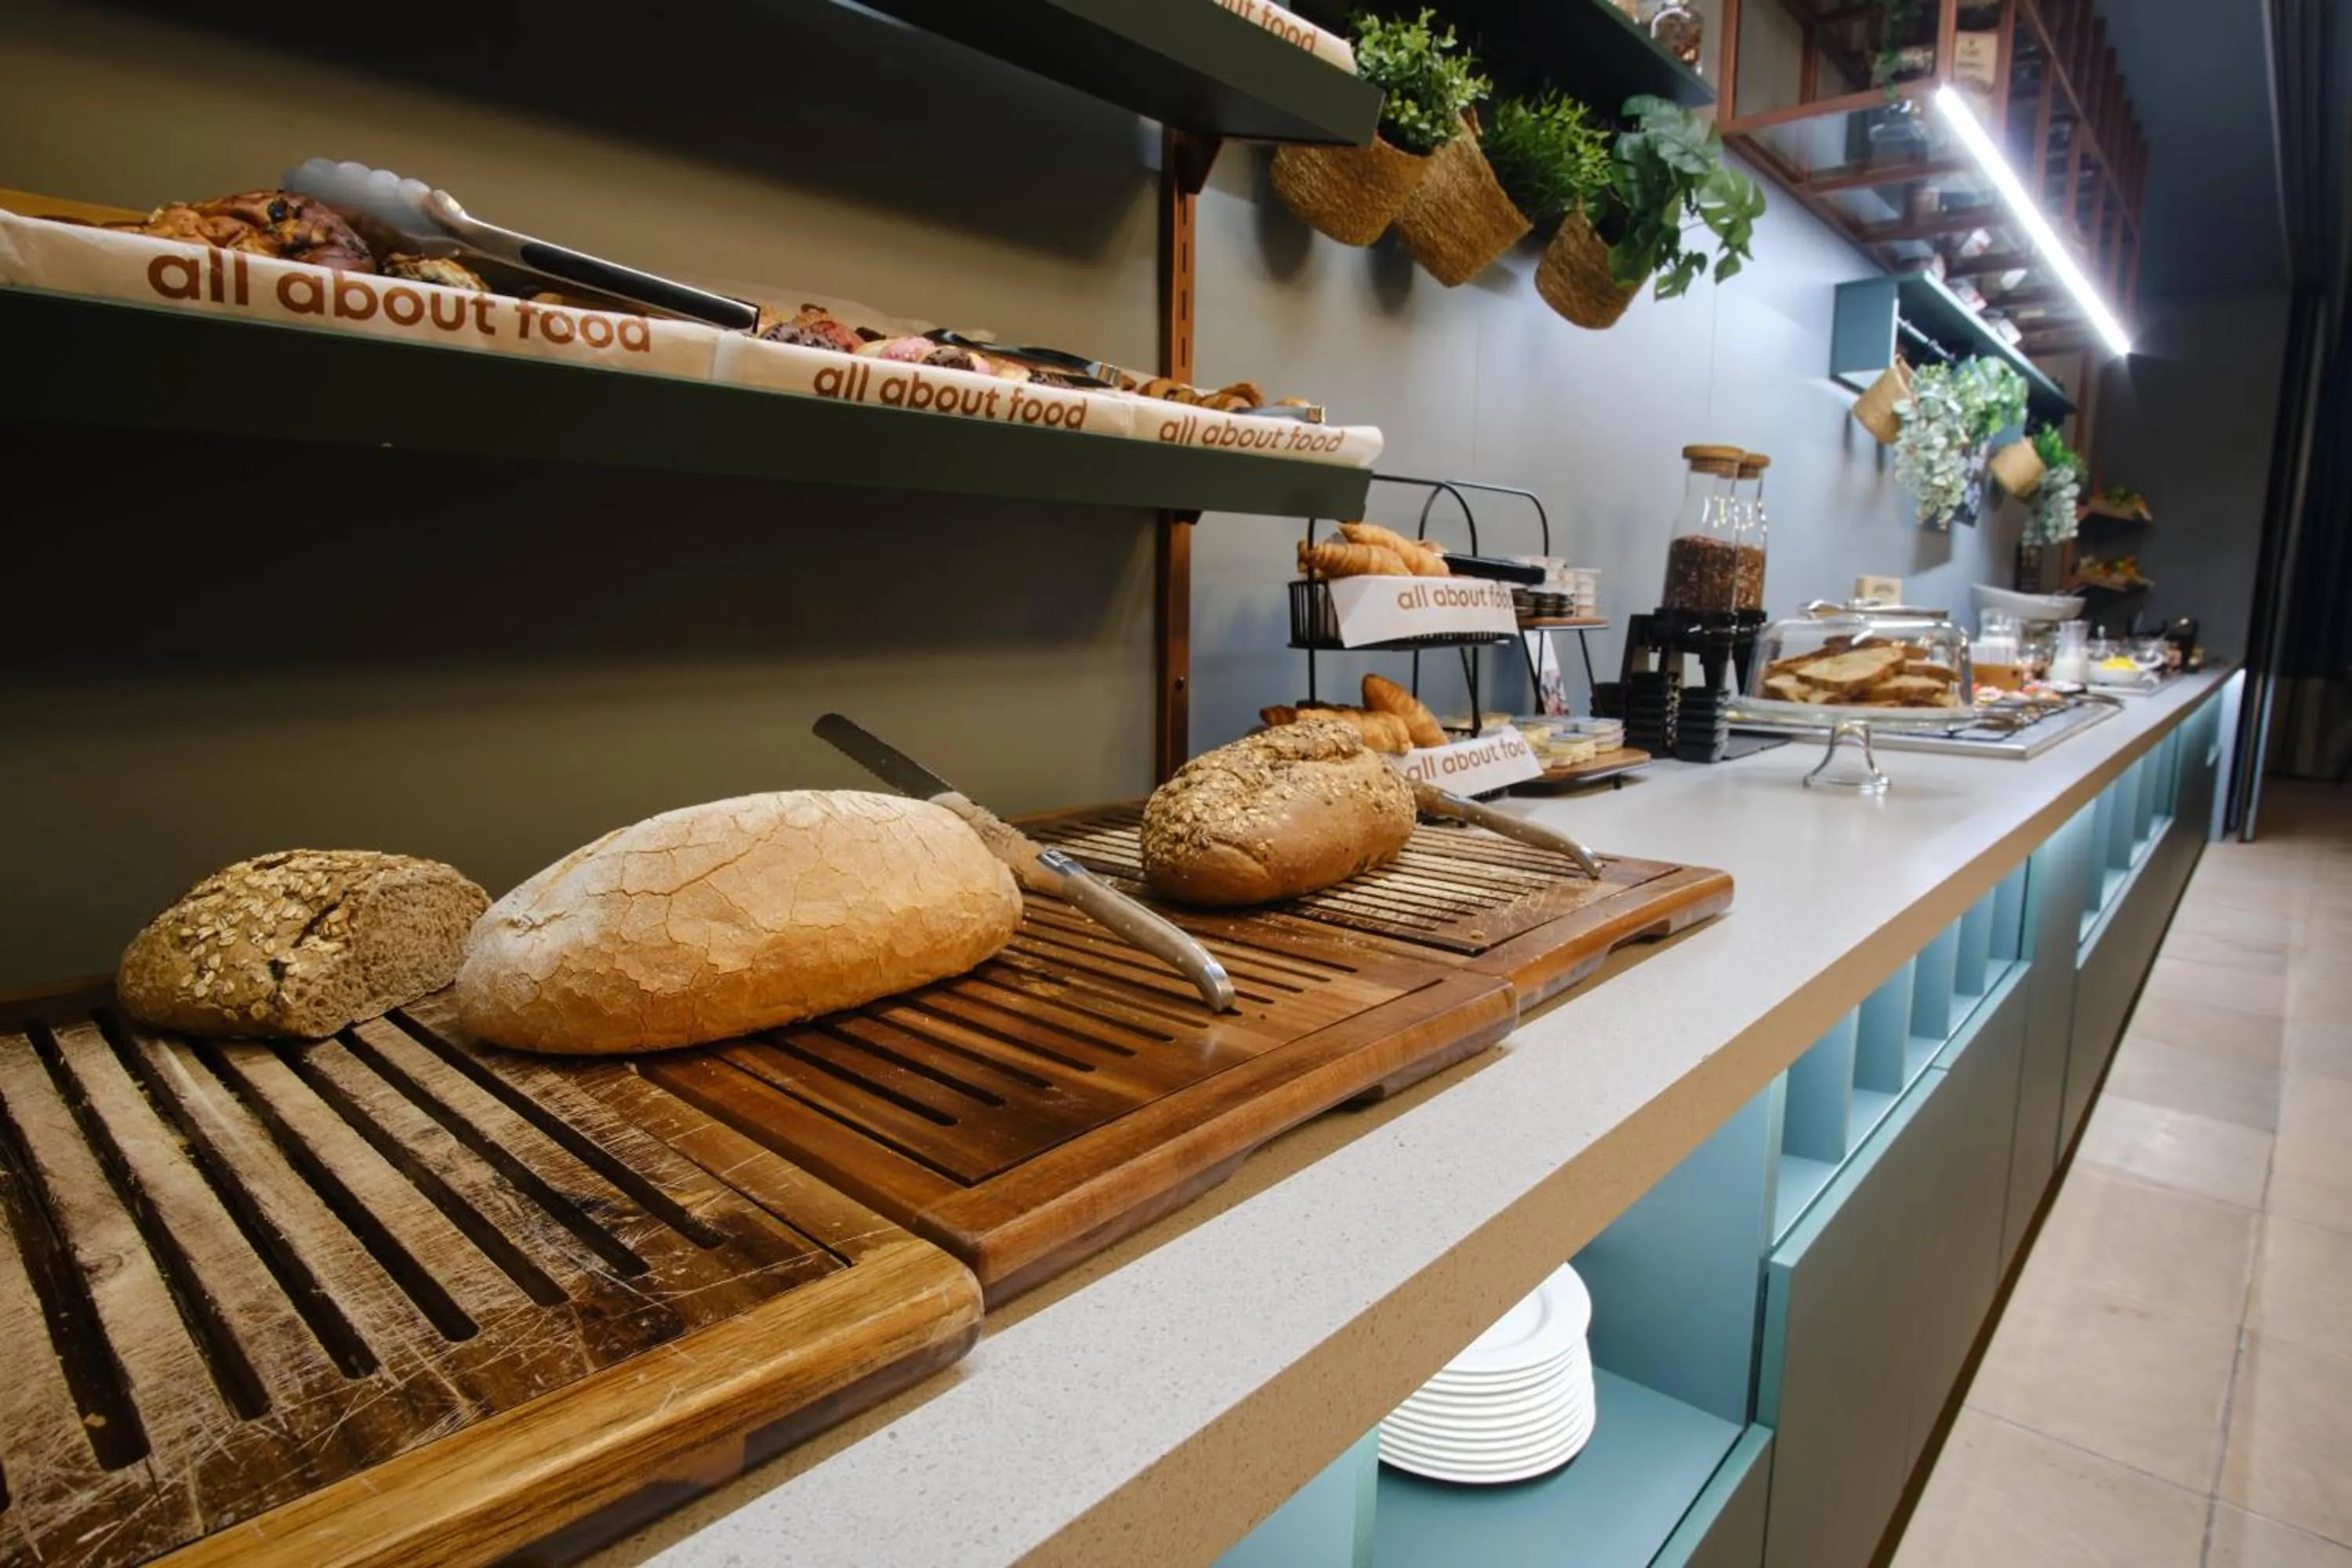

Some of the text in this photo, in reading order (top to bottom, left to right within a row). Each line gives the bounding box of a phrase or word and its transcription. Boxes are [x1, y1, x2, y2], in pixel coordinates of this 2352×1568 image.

[147, 246, 249, 306] all
[277, 269, 496, 335] about
[814, 362, 1088, 430] all about food
[1158, 416, 1345, 452] all about food
[1397, 584, 1428, 610] all
[1433, 584, 1488, 608] about
[1406, 755, 1437, 782] all
[1443, 750, 1501, 775] about
